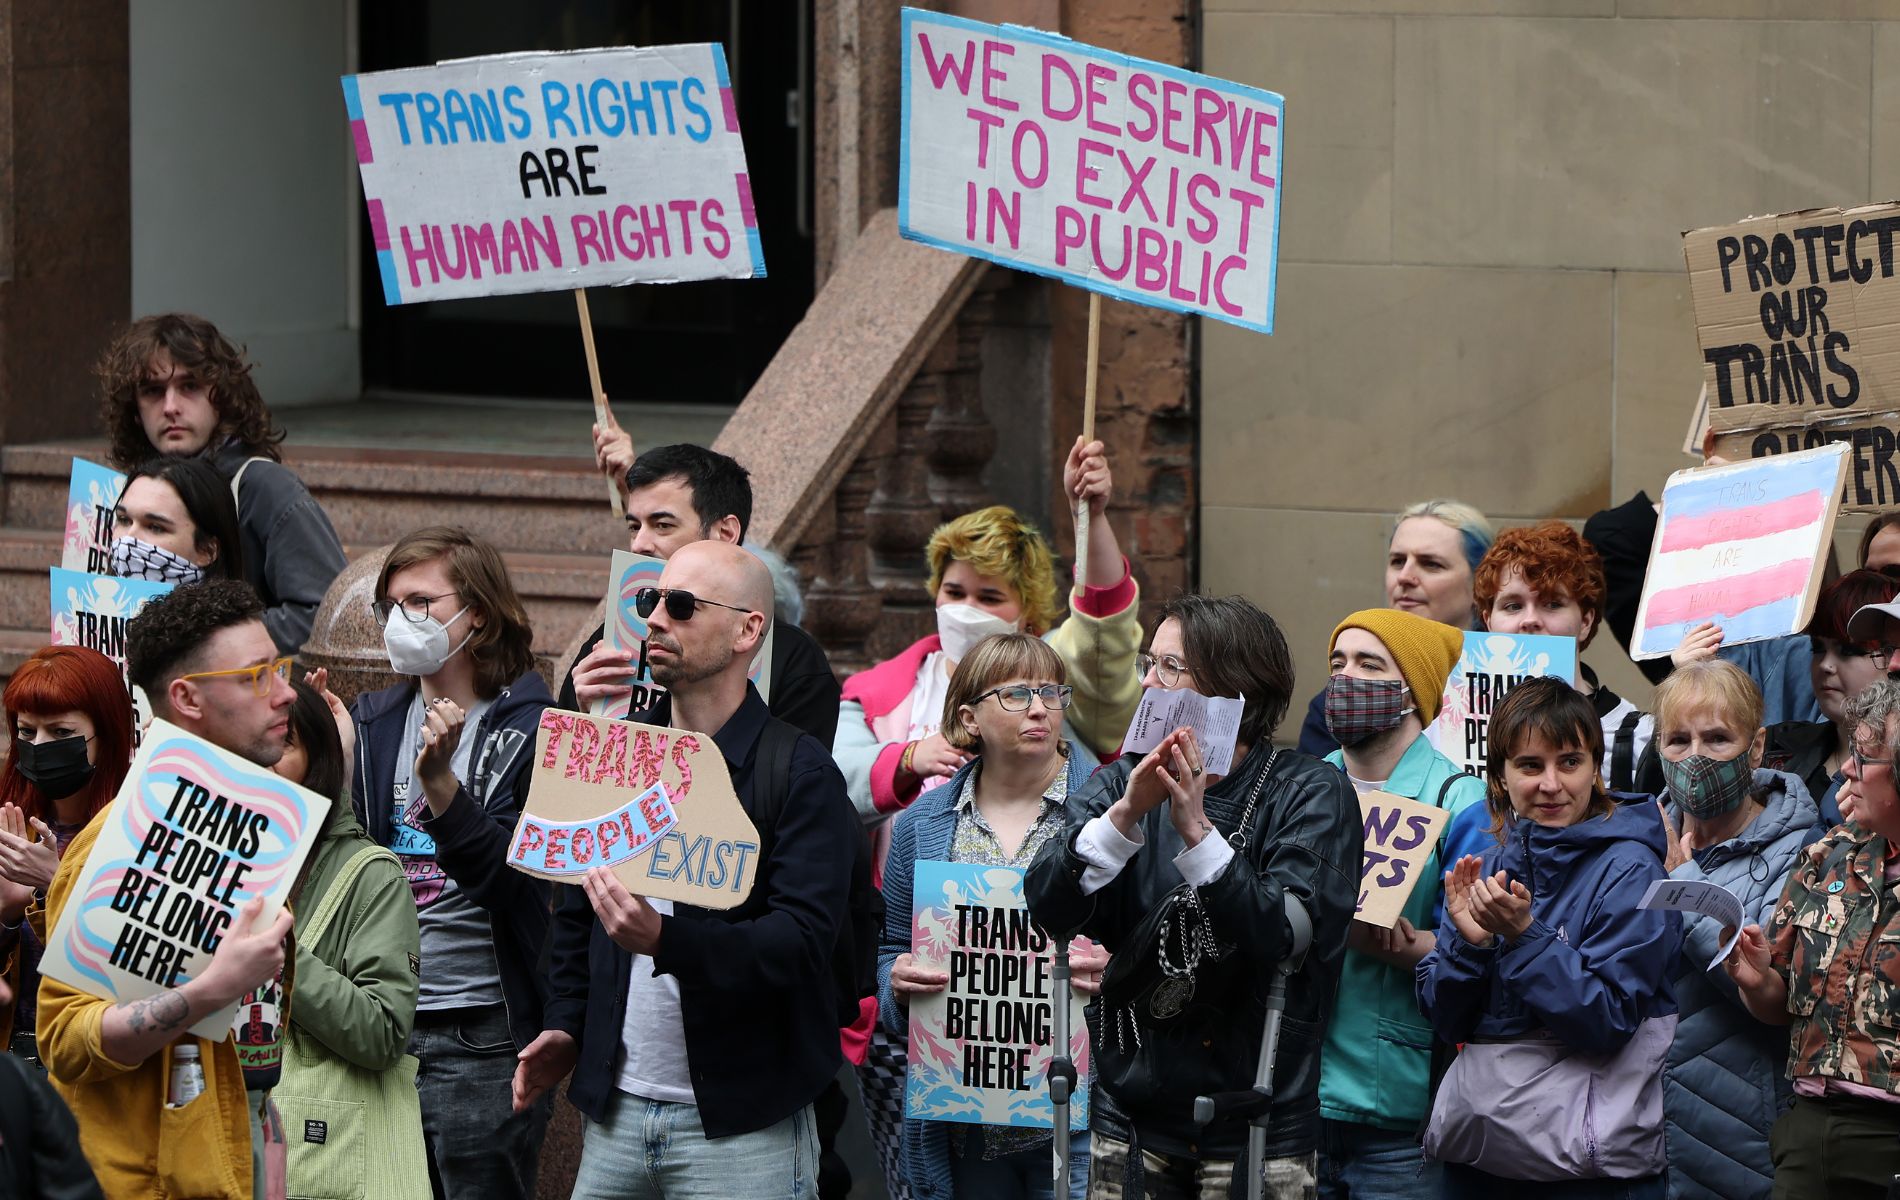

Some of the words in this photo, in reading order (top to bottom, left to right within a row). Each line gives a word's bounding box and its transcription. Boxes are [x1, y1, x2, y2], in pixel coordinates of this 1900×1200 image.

[379, 85, 532, 145] TRANS
[541, 77, 712, 143] RIGHTS
[918, 32, 1019, 112] WE
[1041, 53, 1277, 189] DESERVE
[519, 145, 607, 199] ARE
[966, 108, 1049, 189] TO
[1076, 137, 1265, 255] EXIST
[400, 214, 562, 287] HUMAN
[570, 199, 731, 266] RIGHTS
[966, 181, 1021, 250] IN
[1055, 205, 1247, 317] PUBLIC
[1717, 216, 1900, 293] PROTECT
[1760, 285, 1830, 341] OUR
[1704, 331, 1860, 408] TRANS
[1716, 479, 1769, 505] TRANS
[1712, 547, 1744, 569] ARE
[76, 611, 133, 657] TRAN
[540, 711, 700, 805] TRANS
[164, 776, 269, 859] TRANS
[515, 791, 671, 868] PEOPLE
[135, 821, 252, 909] PEOPLE
[647, 831, 757, 893] EXIST
[110, 866, 232, 956] BELONG
[109, 923, 194, 990] HERE
[950, 951, 1049, 999] PEOPLE
[946, 997, 1051, 1046] BELONG
[963, 1044, 1031, 1091] HERE
